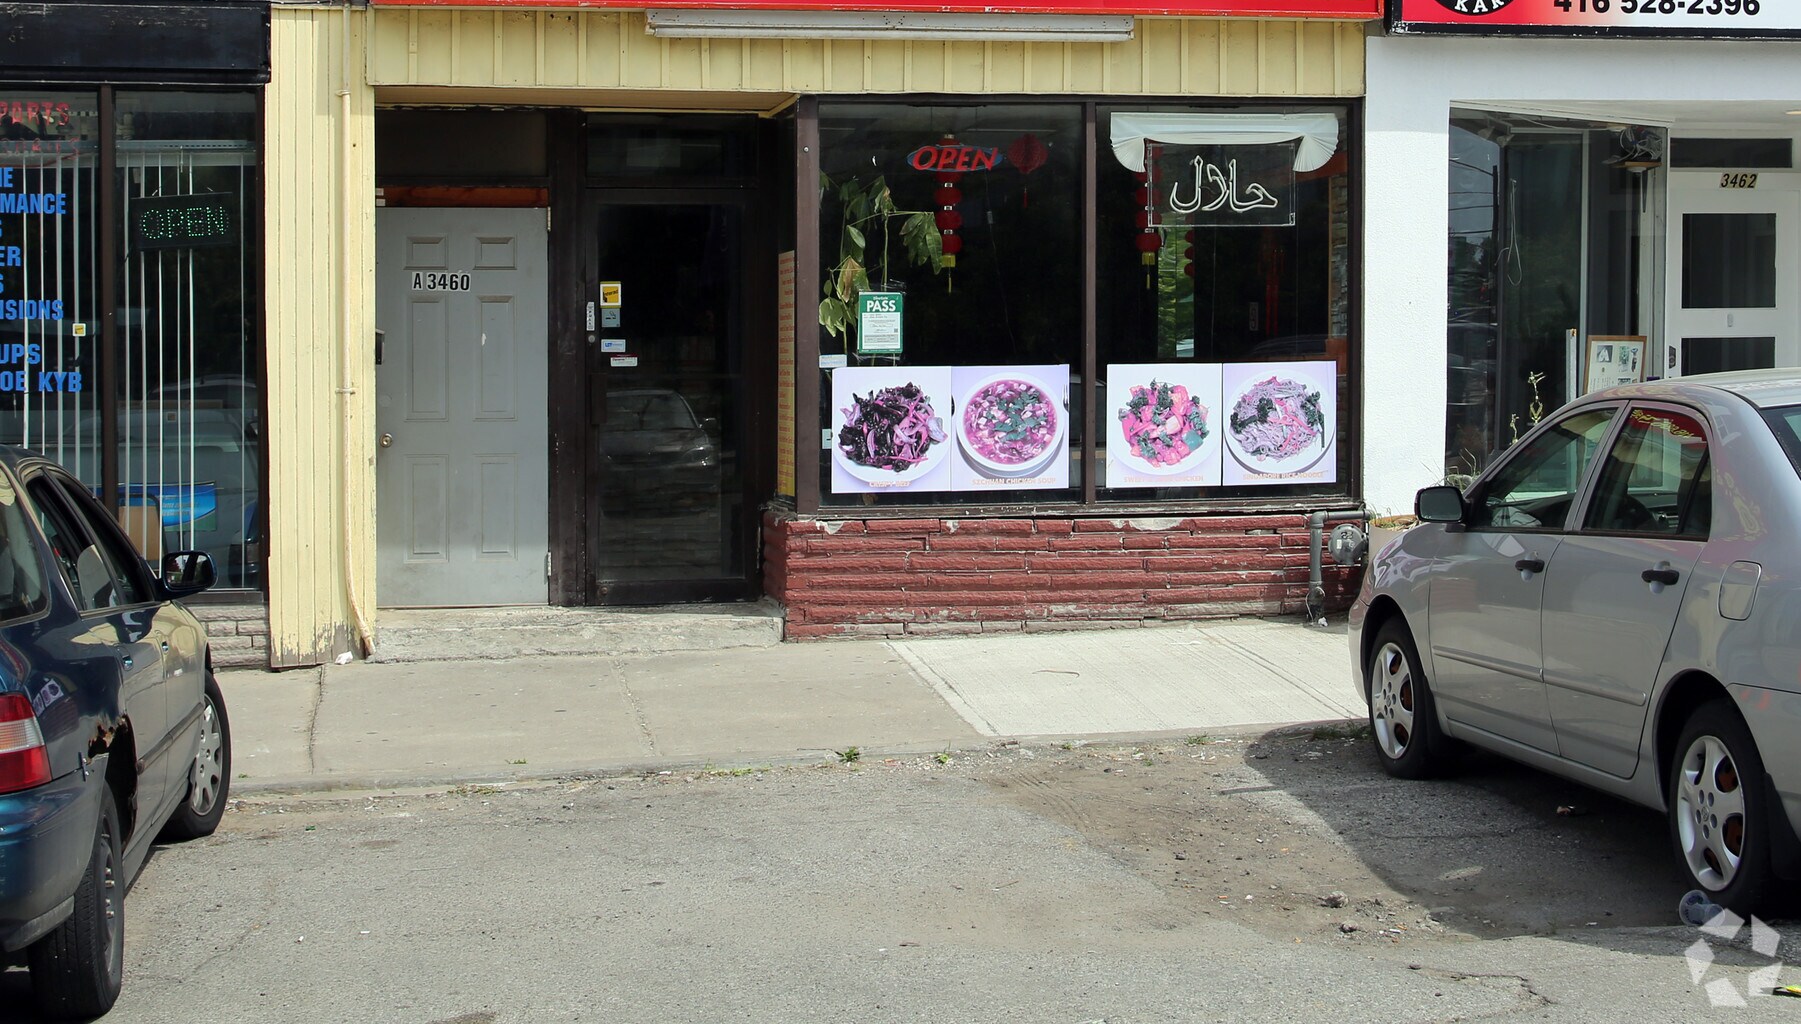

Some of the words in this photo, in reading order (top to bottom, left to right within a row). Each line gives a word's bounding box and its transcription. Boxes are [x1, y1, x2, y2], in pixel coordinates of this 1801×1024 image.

[911, 146, 998, 172] OPEN
[1170, 155, 1278, 213] حلال
[1720, 173, 1757, 188] 3462
[0, 193, 66, 214] MANCE
[141, 206, 229, 239] OPEN
[867, 300, 896, 312] PASS
[39, 372, 82, 392] KYB
